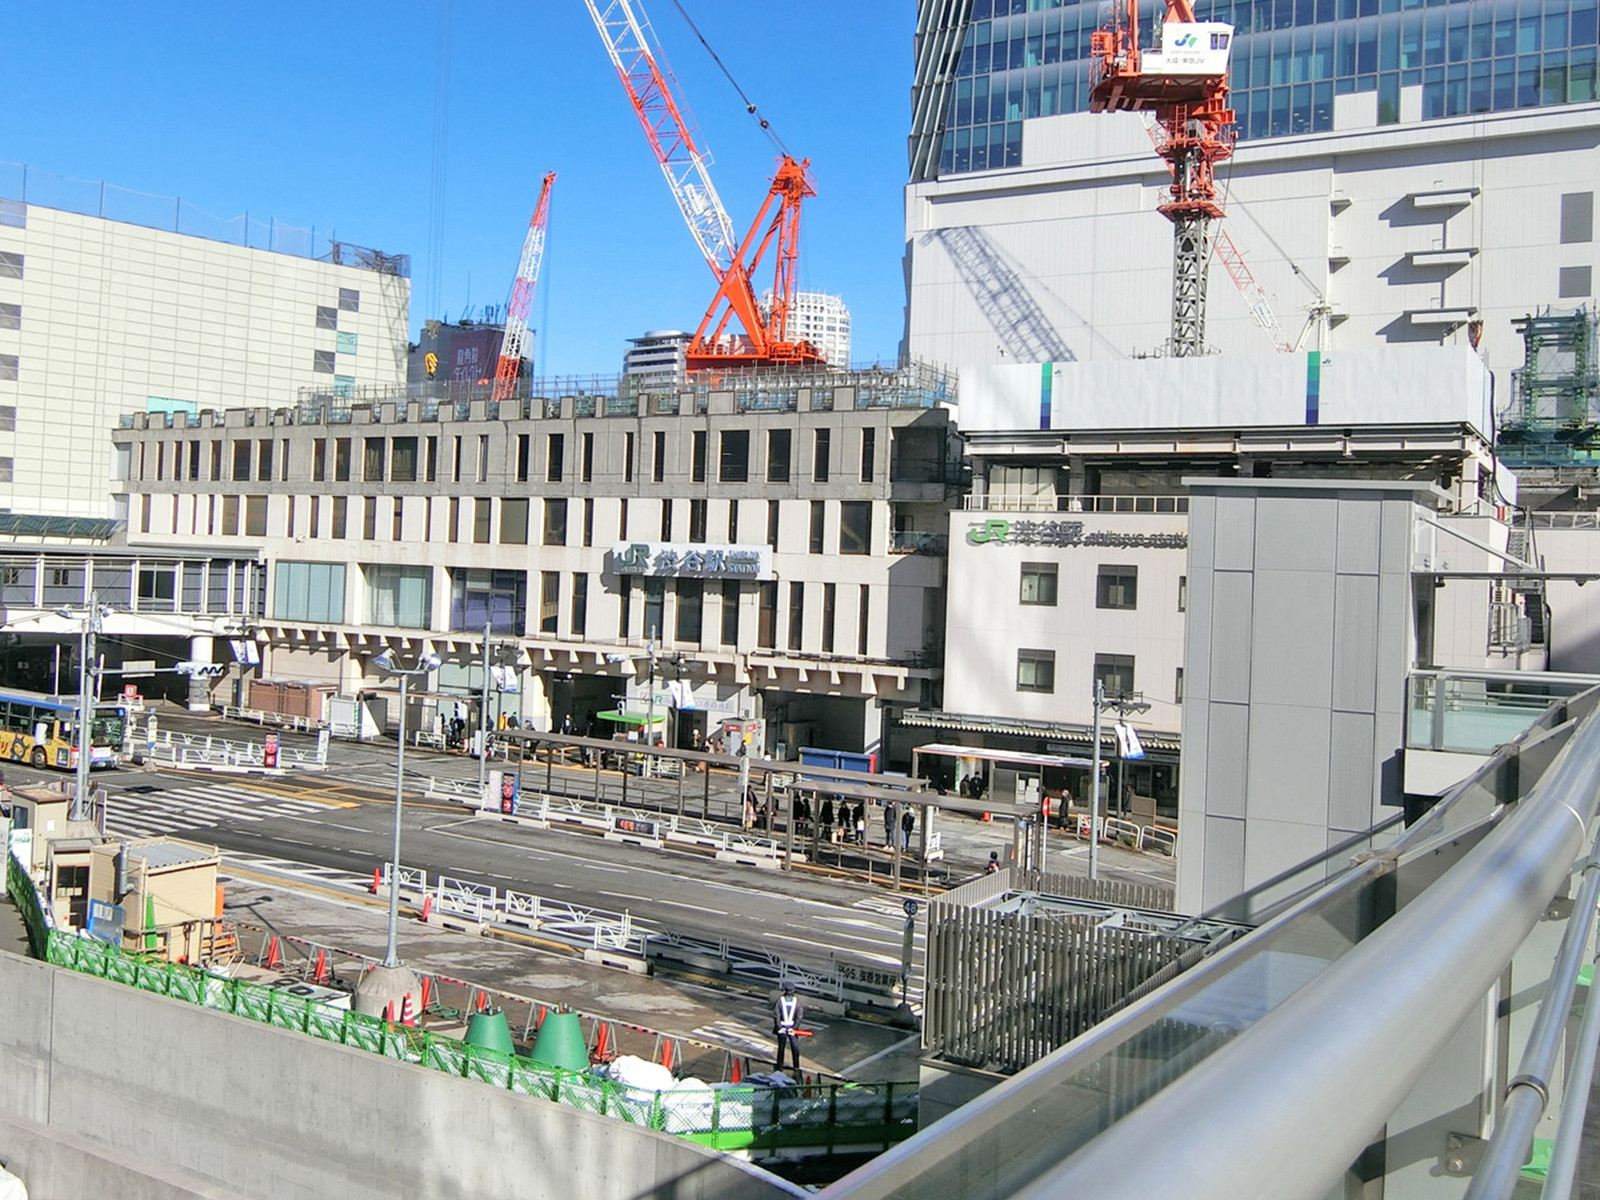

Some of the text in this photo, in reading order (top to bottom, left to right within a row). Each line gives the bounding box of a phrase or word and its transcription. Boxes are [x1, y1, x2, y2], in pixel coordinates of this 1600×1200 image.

[970, 519, 1010, 543] JR
[1014, 520, 1084, 546] 渋谷駅
[614, 543, 727, 573] JR 渋谷駅
[904, 902, 916, 914] 48
